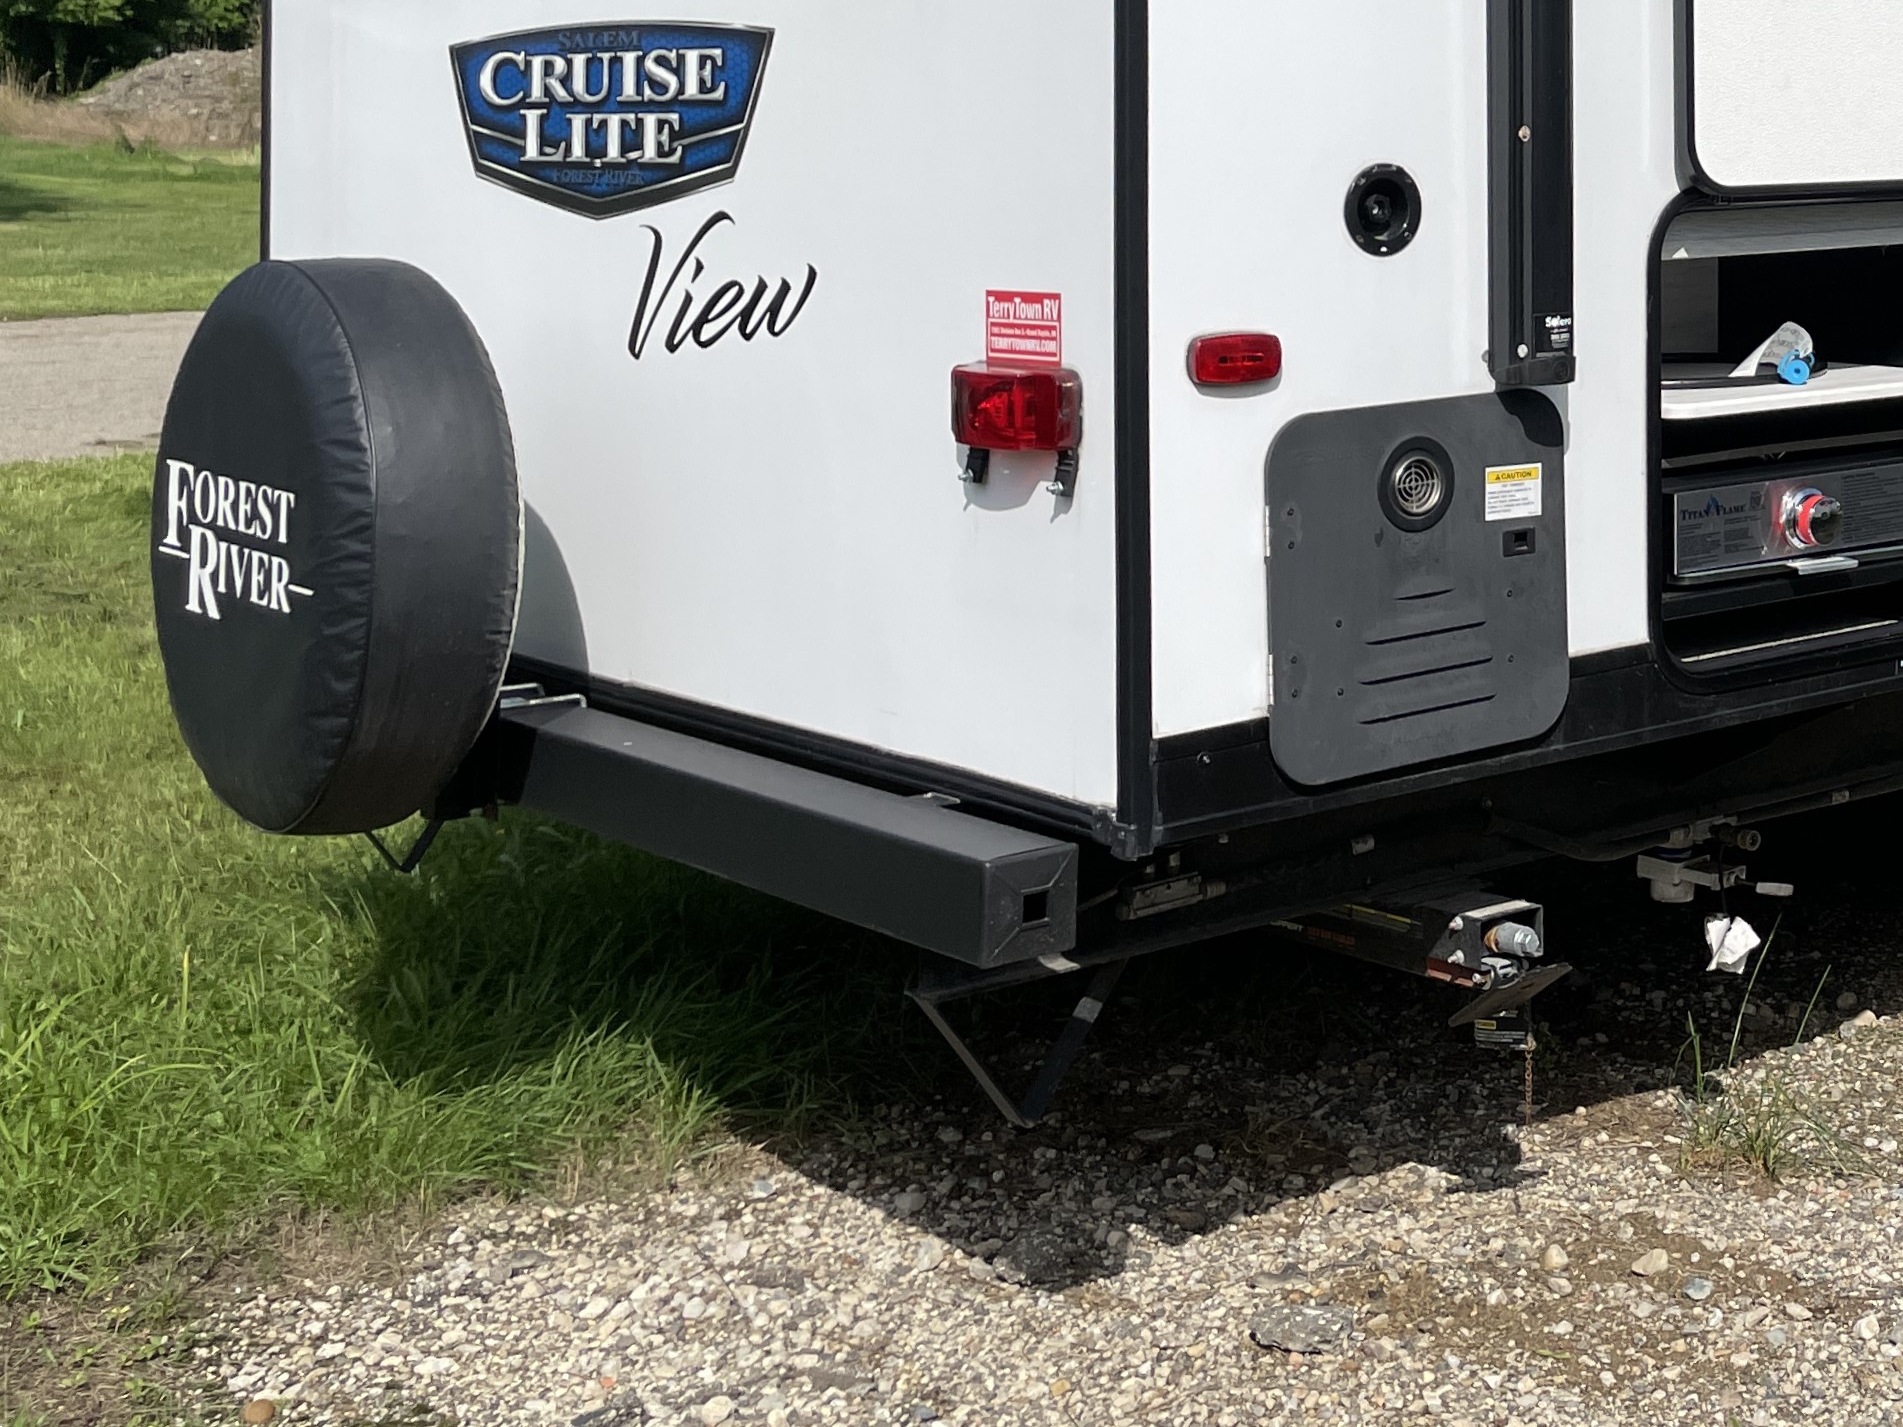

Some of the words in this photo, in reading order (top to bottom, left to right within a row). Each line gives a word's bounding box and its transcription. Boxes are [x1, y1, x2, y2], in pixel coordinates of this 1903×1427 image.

[558, 29, 641, 49] SALEM
[479, 48, 726, 106] CRUISE
[519, 108, 683, 165] LITE
[552, 169, 600, 185] FOREST
[604, 169, 645, 186] RIVER
[627, 210, 818, 361] View
[1043, 298, 1059, 321] RV
[163, 459, 296, 548] FOREST
[1501, 470, 1532, 480] CAUTION
[185, 524, 292, 620] RIVER
